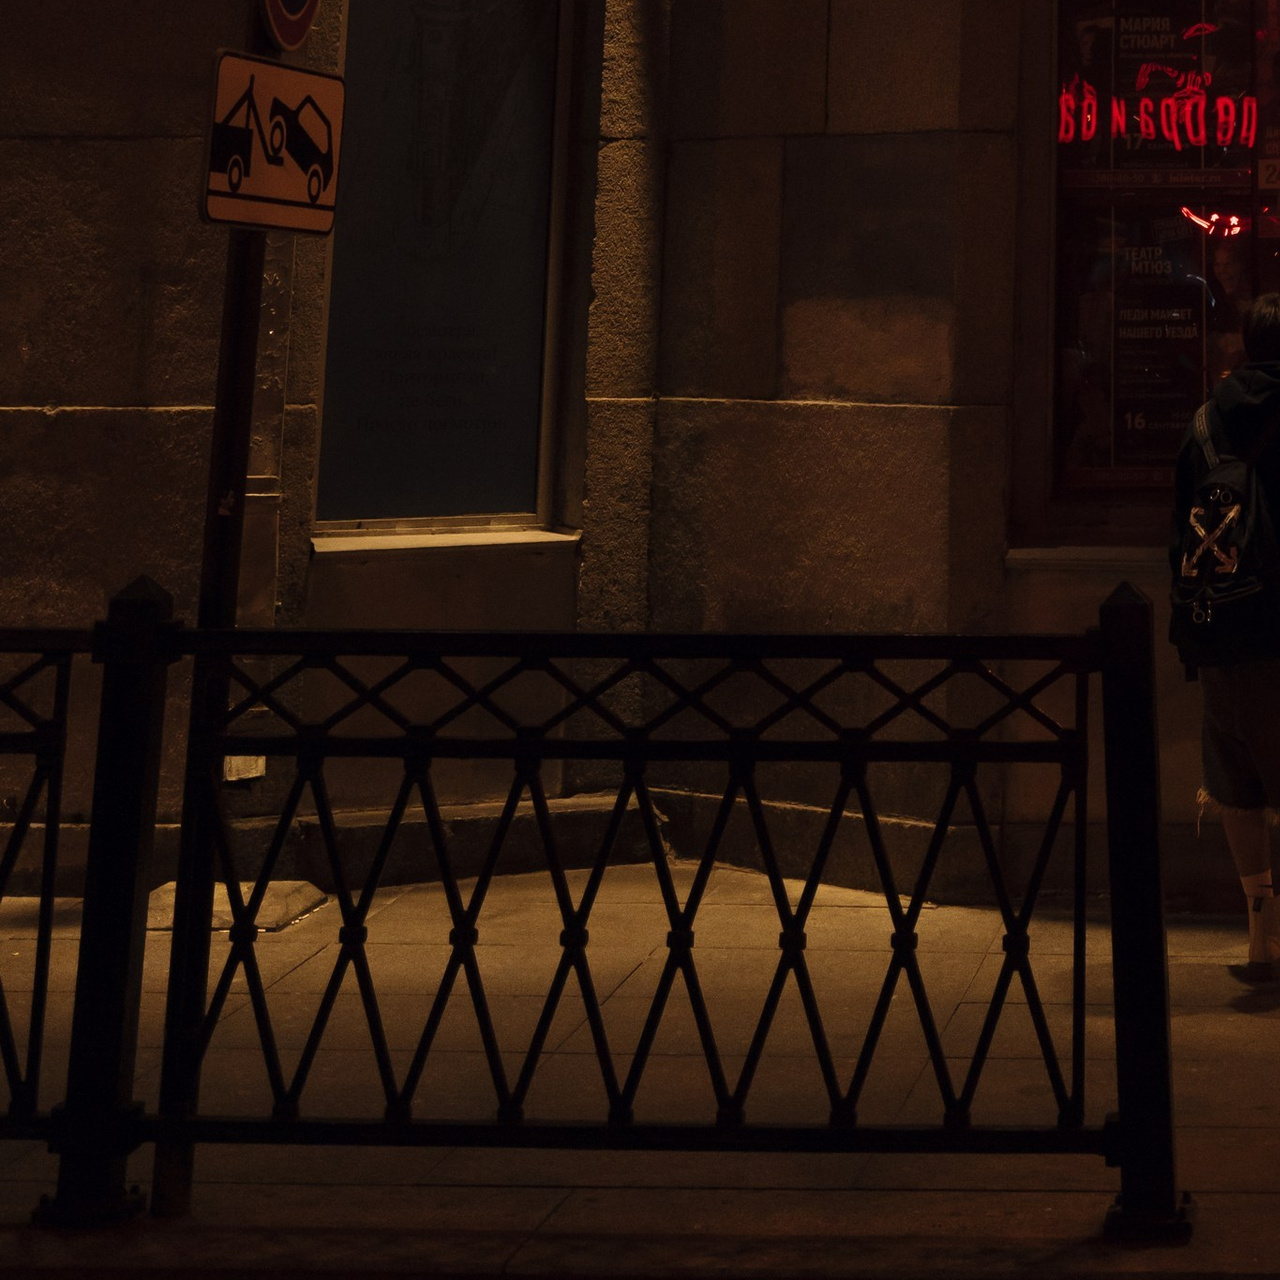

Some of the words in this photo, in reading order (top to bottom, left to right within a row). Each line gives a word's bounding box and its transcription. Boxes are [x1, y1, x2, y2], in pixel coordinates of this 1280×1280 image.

[1119, 17, 1171, 32] МАРИЯ
[1119, 34, 1177, 49] СТЮАРТ
[1124, 133, 1144, 150] 17
[1124, 246, 1163, 261] ТЕАТР
[1131, 260, 1173, 275] МТЮЗ
[1119, 308, 1149, 321] ЛЕДИ
[1119, 326, 1162, 339] НАШЕГО
[1124, 412, 1146, 430] 16
